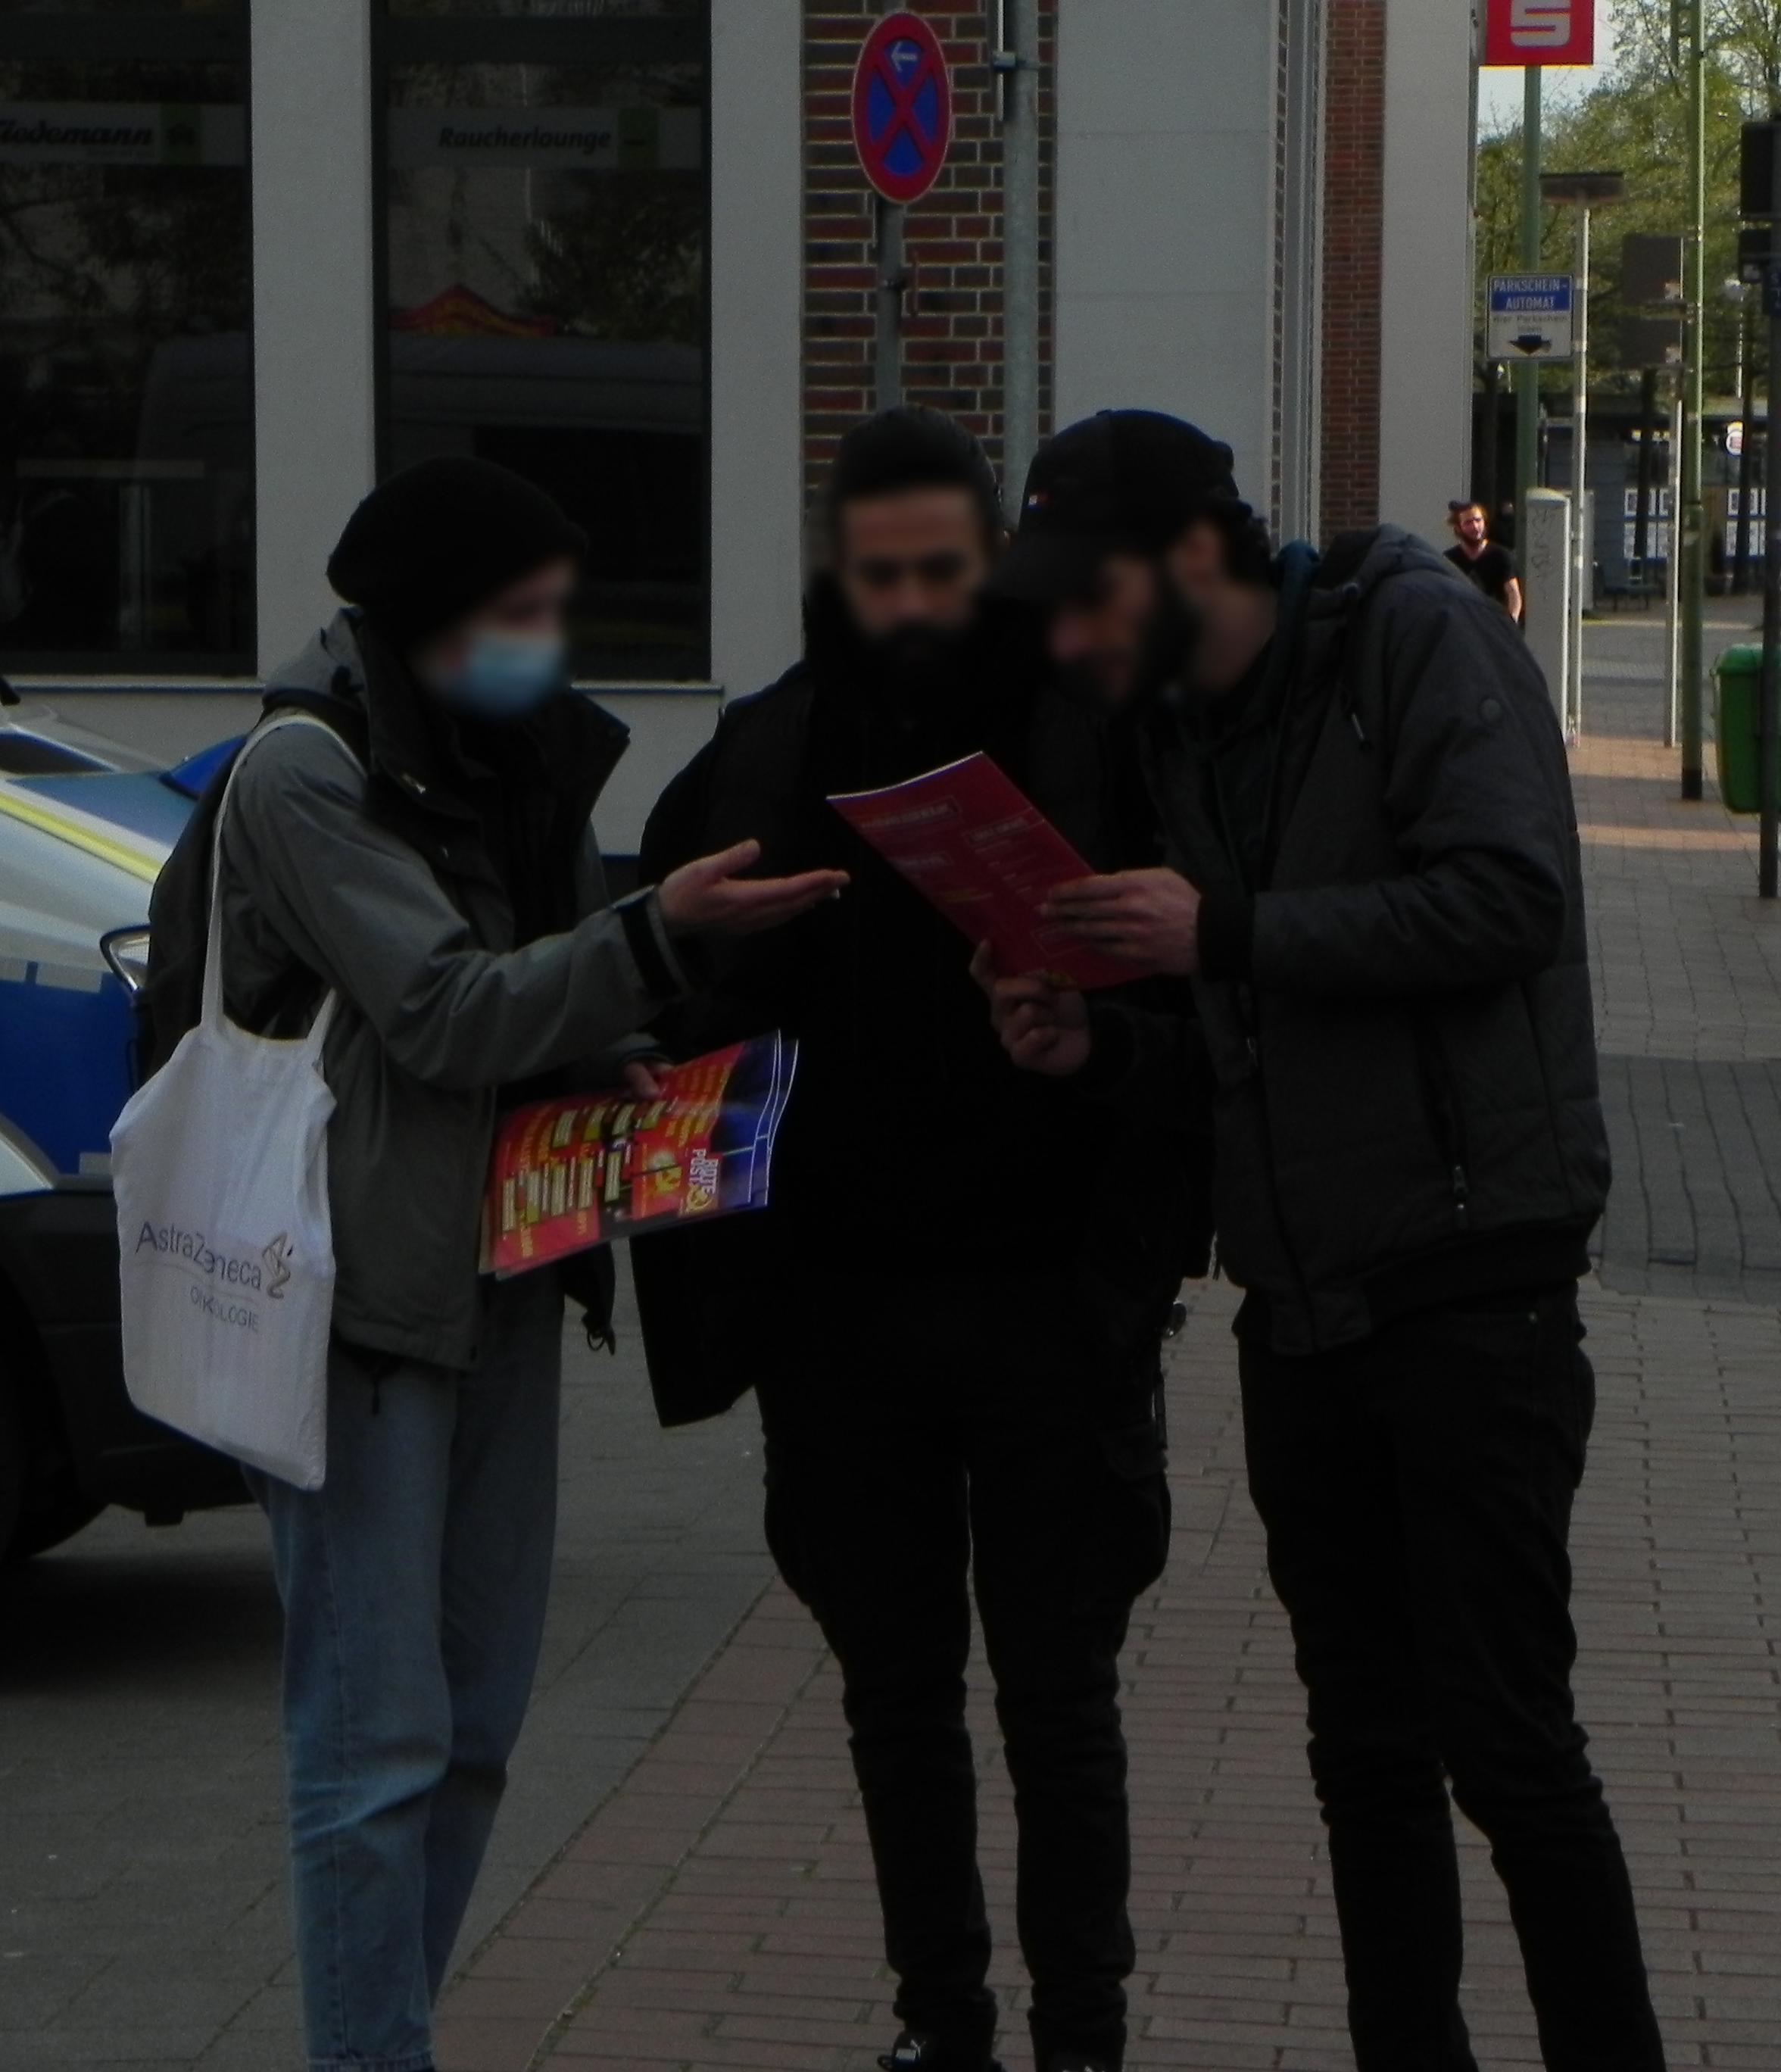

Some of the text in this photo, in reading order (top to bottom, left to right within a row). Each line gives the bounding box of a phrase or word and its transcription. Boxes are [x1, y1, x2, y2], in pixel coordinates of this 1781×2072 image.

[0, 119, 152, 145] iedemann
[438, 125, 610, 154] Raucherlounge
[1493, 278, 1567, 292] PARKSCHEIN-
[1505, 296, 1555, 310] AUTOMAT
